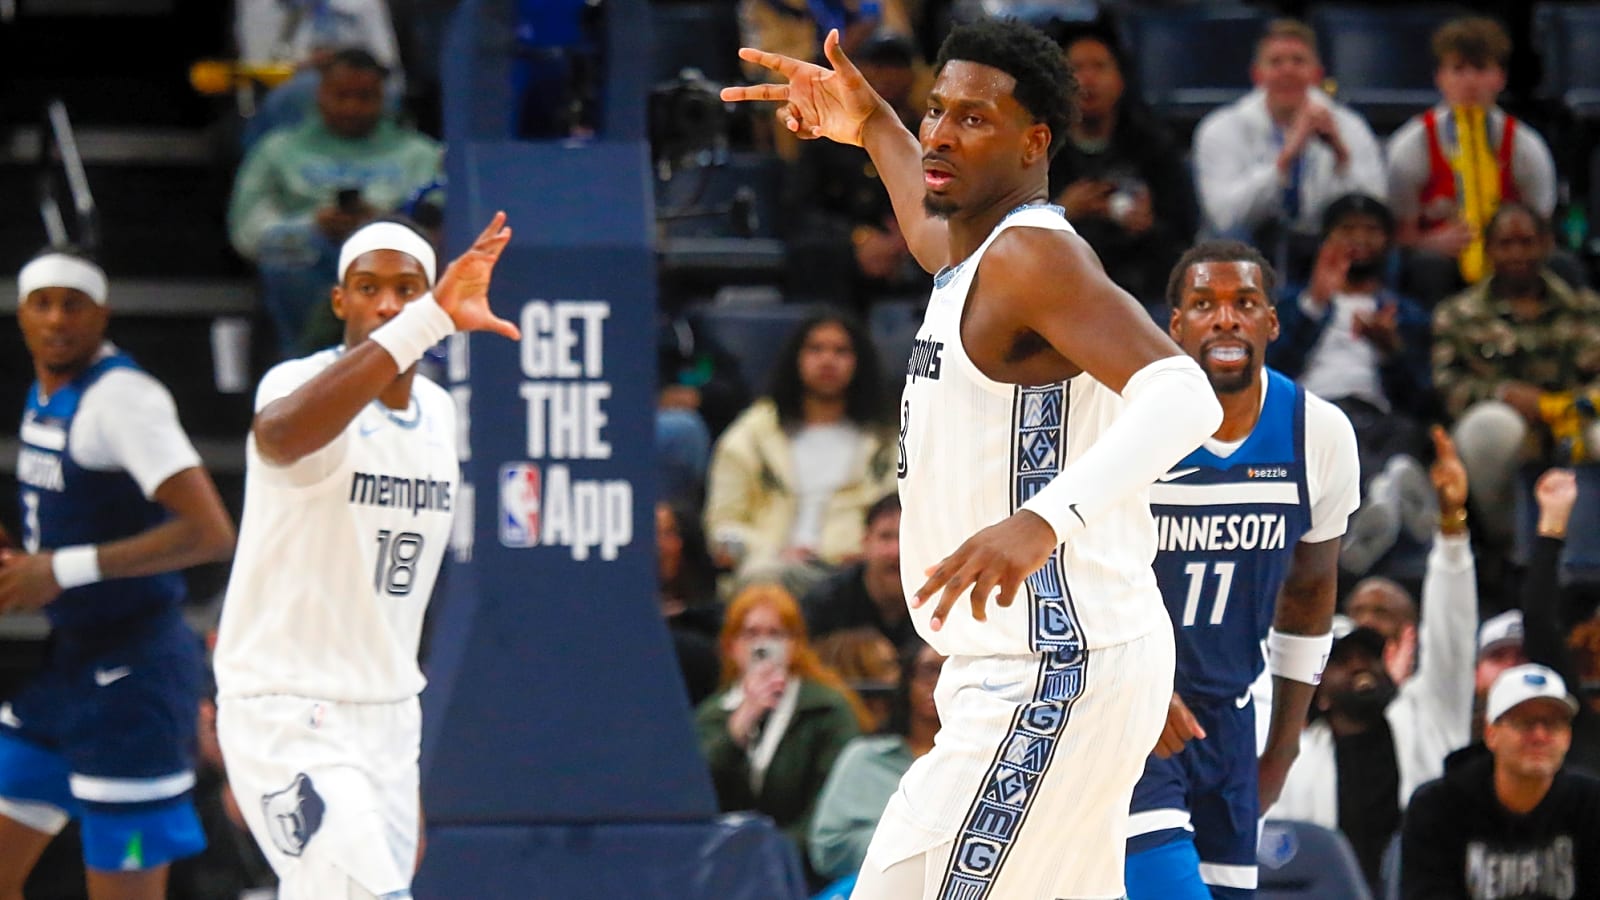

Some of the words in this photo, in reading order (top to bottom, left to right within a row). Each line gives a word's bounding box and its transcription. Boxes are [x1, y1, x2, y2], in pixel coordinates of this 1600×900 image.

[520, 301, 610, 378] GET
[519, 382, 612, 459] THE
[349, 472, 450, 517] memphis
[1254, 467, 1288, 478] sezzle
[542, 464, 633, 561] App
[1155, 514, 1286, 551] INNESOTA
[374, 529, 424, 596] 18
[1182, 562, 1236, 627] 11
